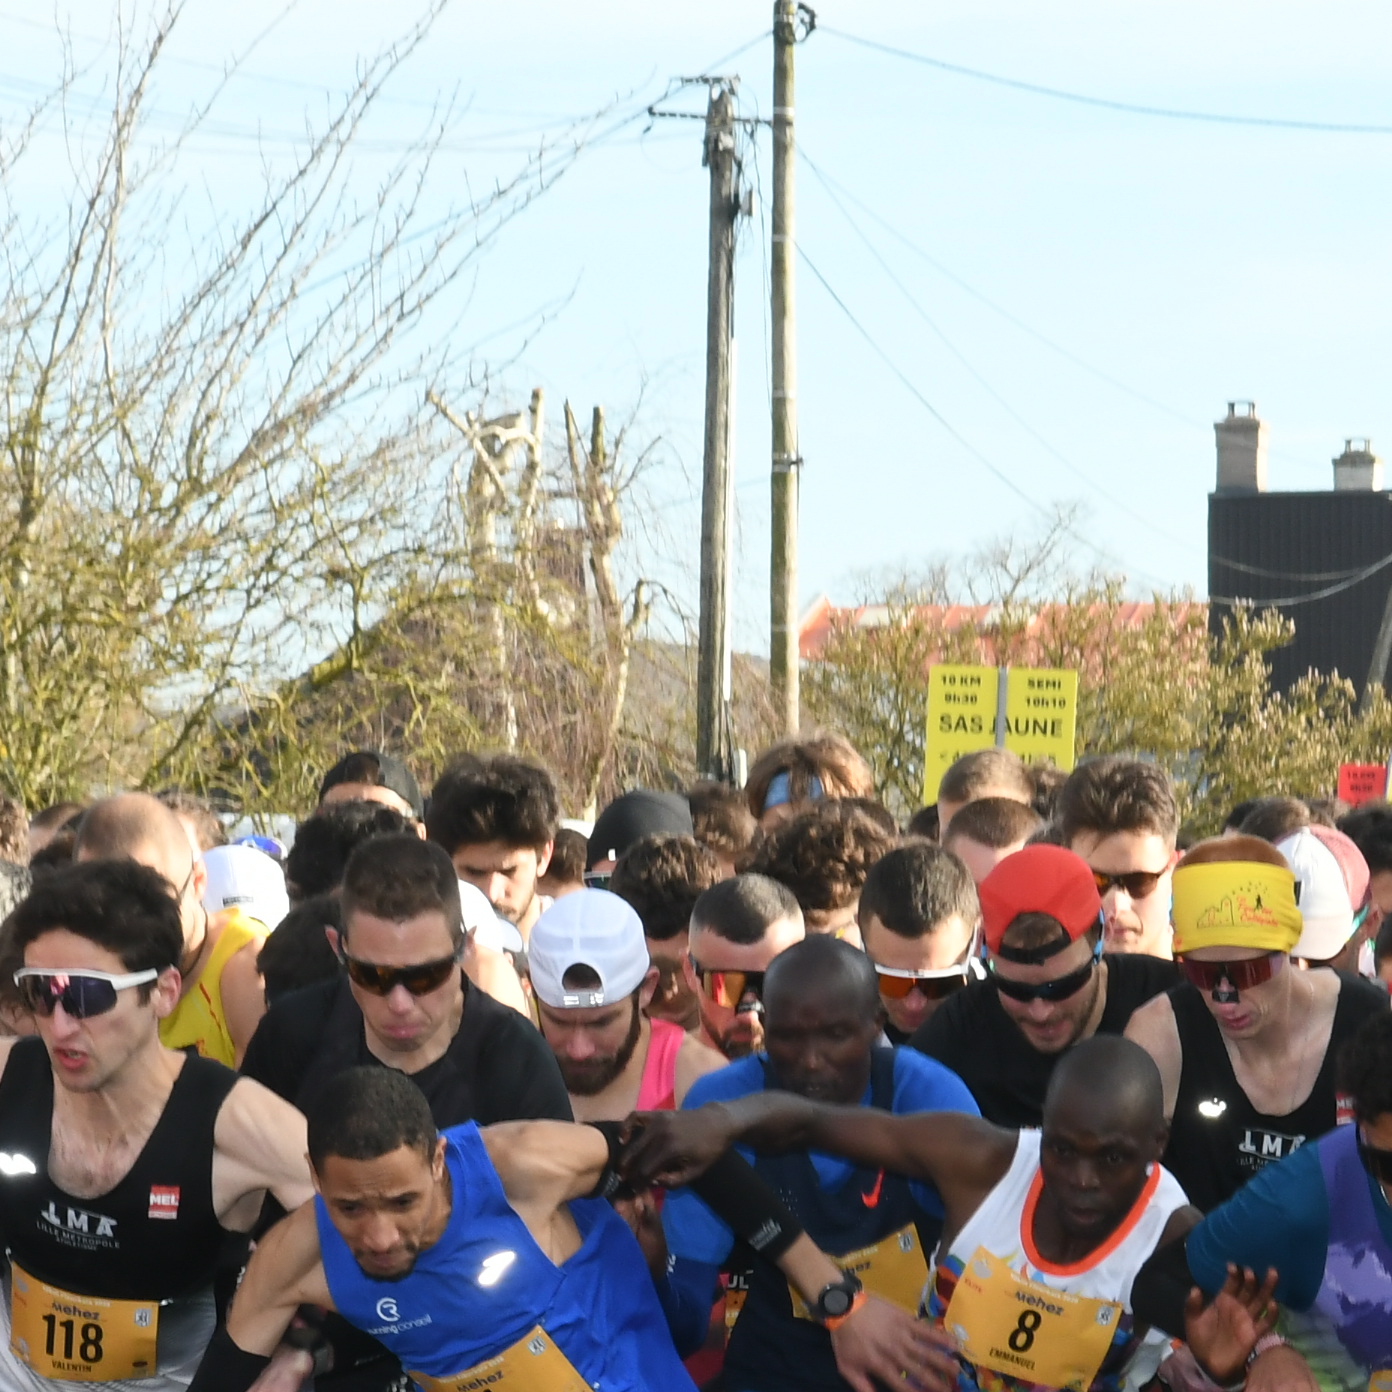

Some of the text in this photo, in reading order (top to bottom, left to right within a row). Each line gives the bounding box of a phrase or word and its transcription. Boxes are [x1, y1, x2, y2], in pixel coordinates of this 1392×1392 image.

[960, 674, 982, 688] KM
[1027, 677, 1062, 691] SEMI
[939, 712, 984, 734] SAS
[149, 1192, 180, 1207] MEL
[40, 1199, 118, 1238] LMA
[41, 1313, 104, 1364] 118
[1008, 1309, 1042, 1354] 8
[51, 1359, 93, 1373] VALENTIN
[988, 1346, 1037, 1372] EMMANUEL
